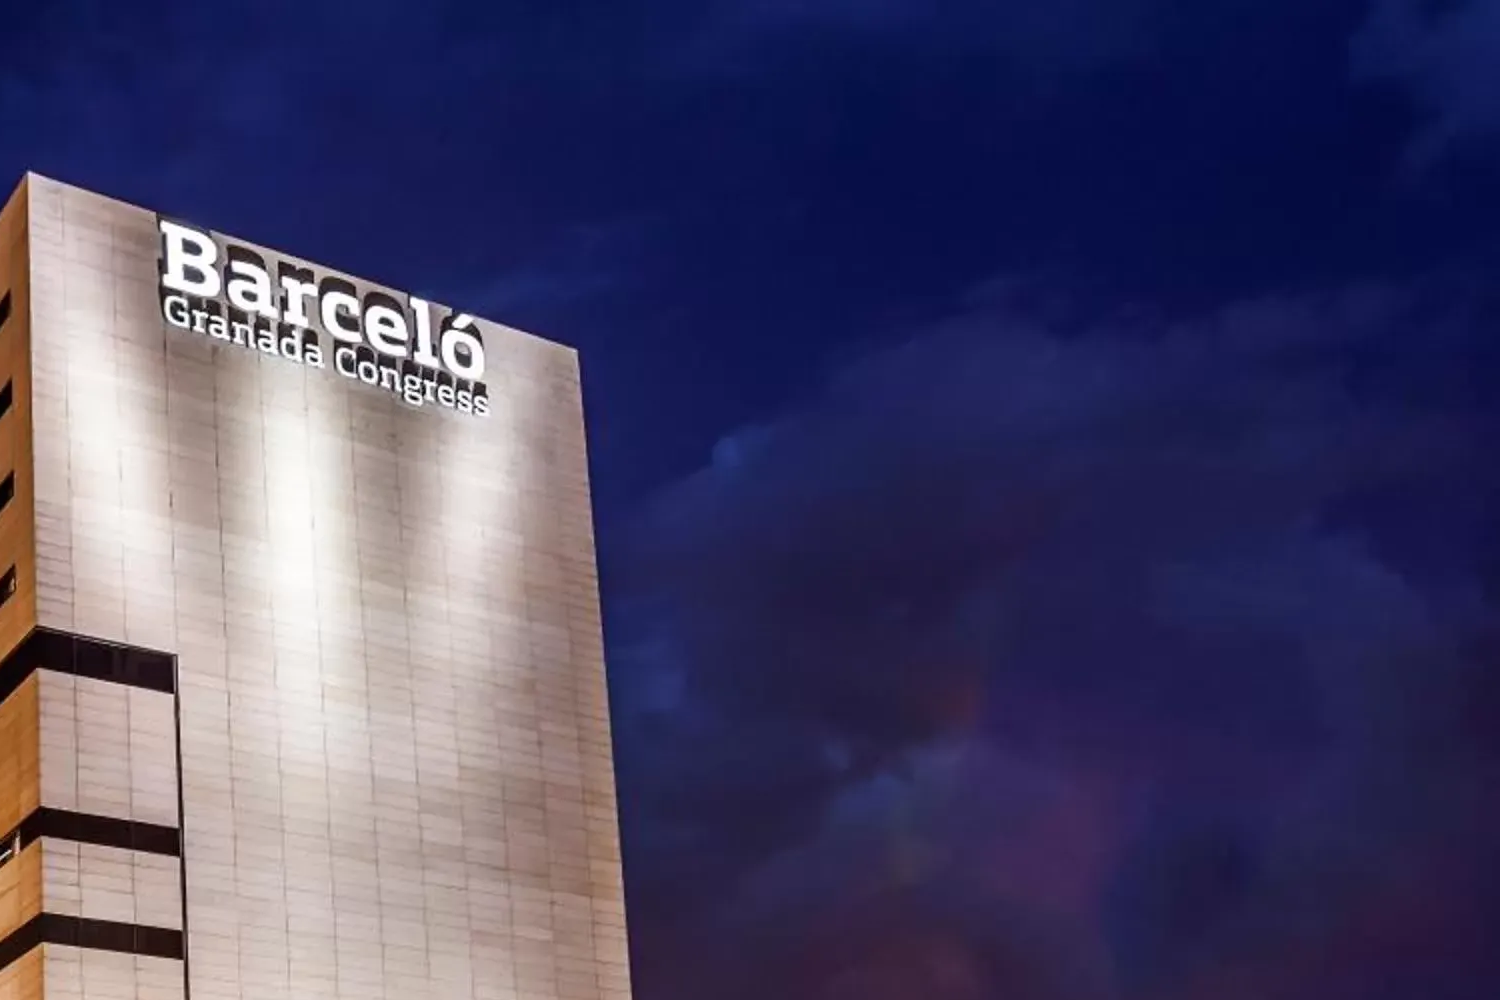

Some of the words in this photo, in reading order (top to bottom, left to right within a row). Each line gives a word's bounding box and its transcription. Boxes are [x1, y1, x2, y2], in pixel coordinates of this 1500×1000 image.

[160, 220, 485, 380] Barceló
[164, 295, 325, 369] Granada
[335, 346, 491, 417] Congress
